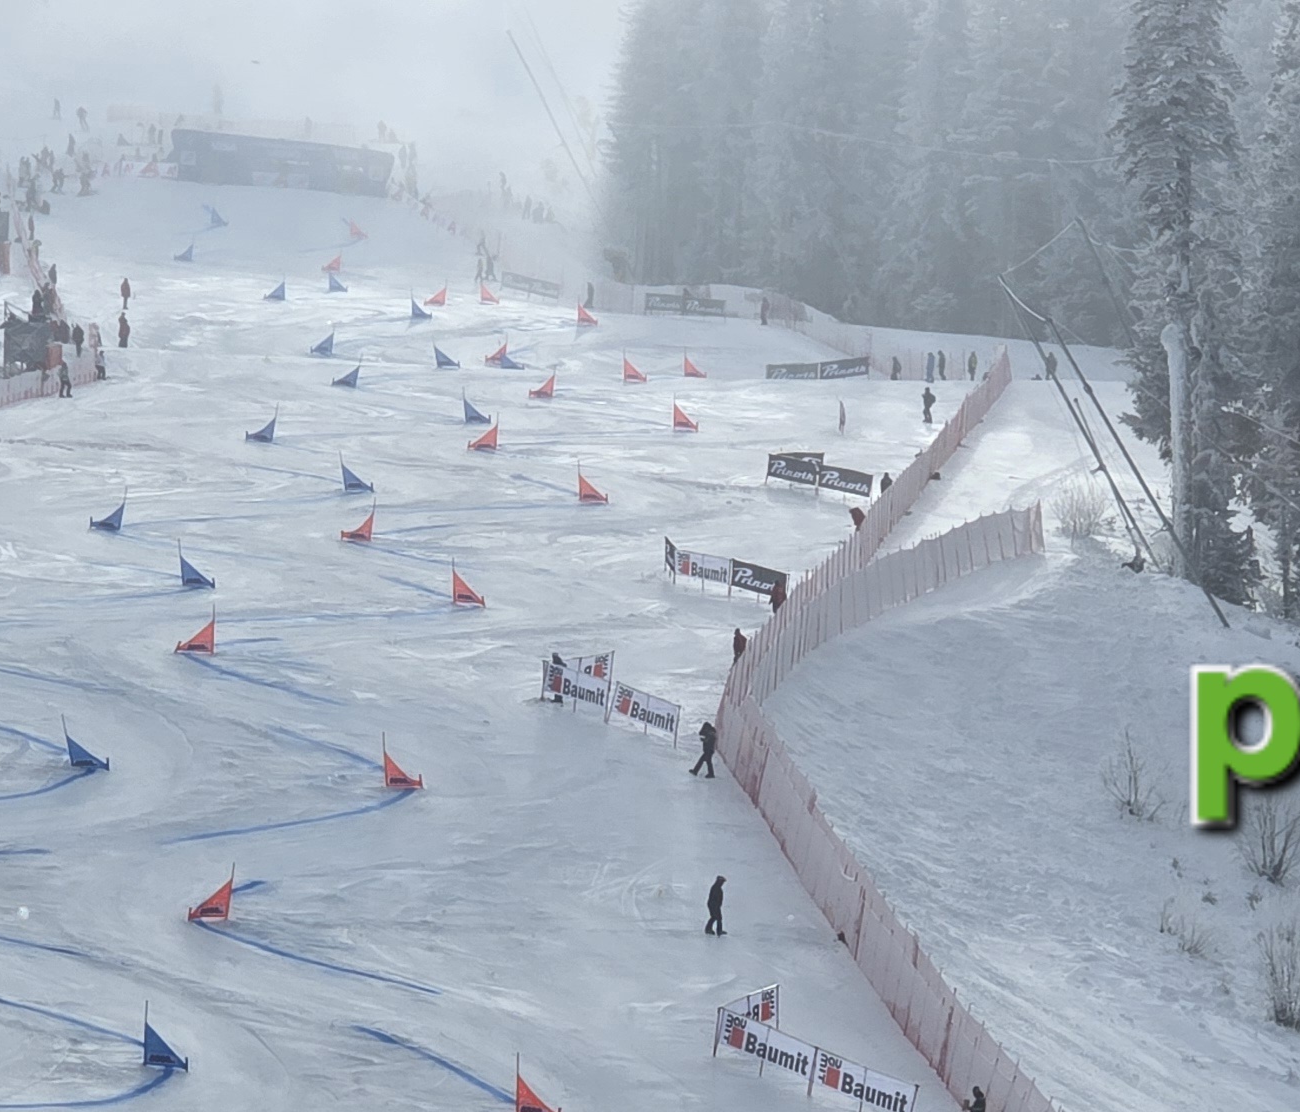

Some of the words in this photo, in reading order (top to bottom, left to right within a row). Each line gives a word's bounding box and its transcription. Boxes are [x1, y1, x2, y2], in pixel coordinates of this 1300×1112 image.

[690, 561, 728, 584] Baumit
[563, 677, 605, 706] Baumit
[630, 701, 675, 732] Baumit
[744, 1031, 809, 1076] Baumit
